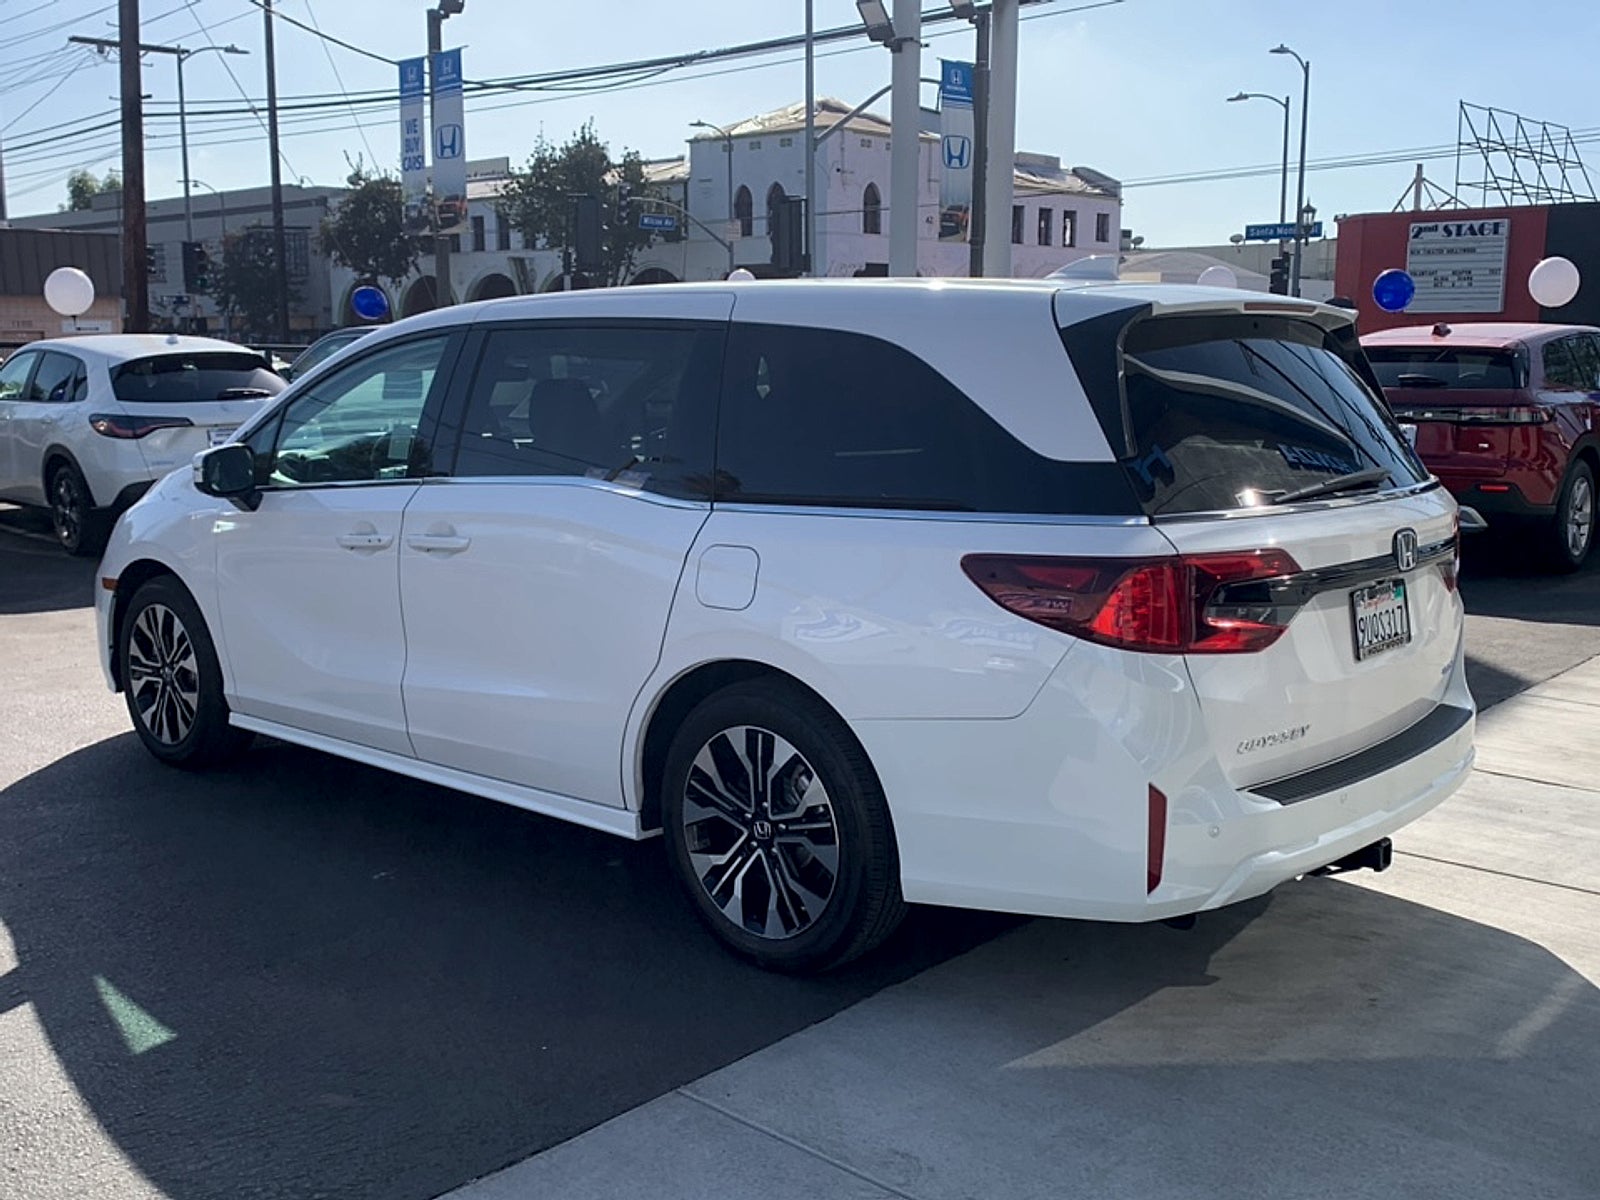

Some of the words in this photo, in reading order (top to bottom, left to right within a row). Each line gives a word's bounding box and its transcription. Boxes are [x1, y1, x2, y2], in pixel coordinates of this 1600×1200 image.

[405, 118, 418, 135] WE
[404, 136, 421, 153] BUY
[402, 154, 425, 172] CARS!
[1249, 226, 1274, 237] Santa
[1411, 224, 1438, 240] 2nd
[1442, 221, 1505, 238] STAGE
